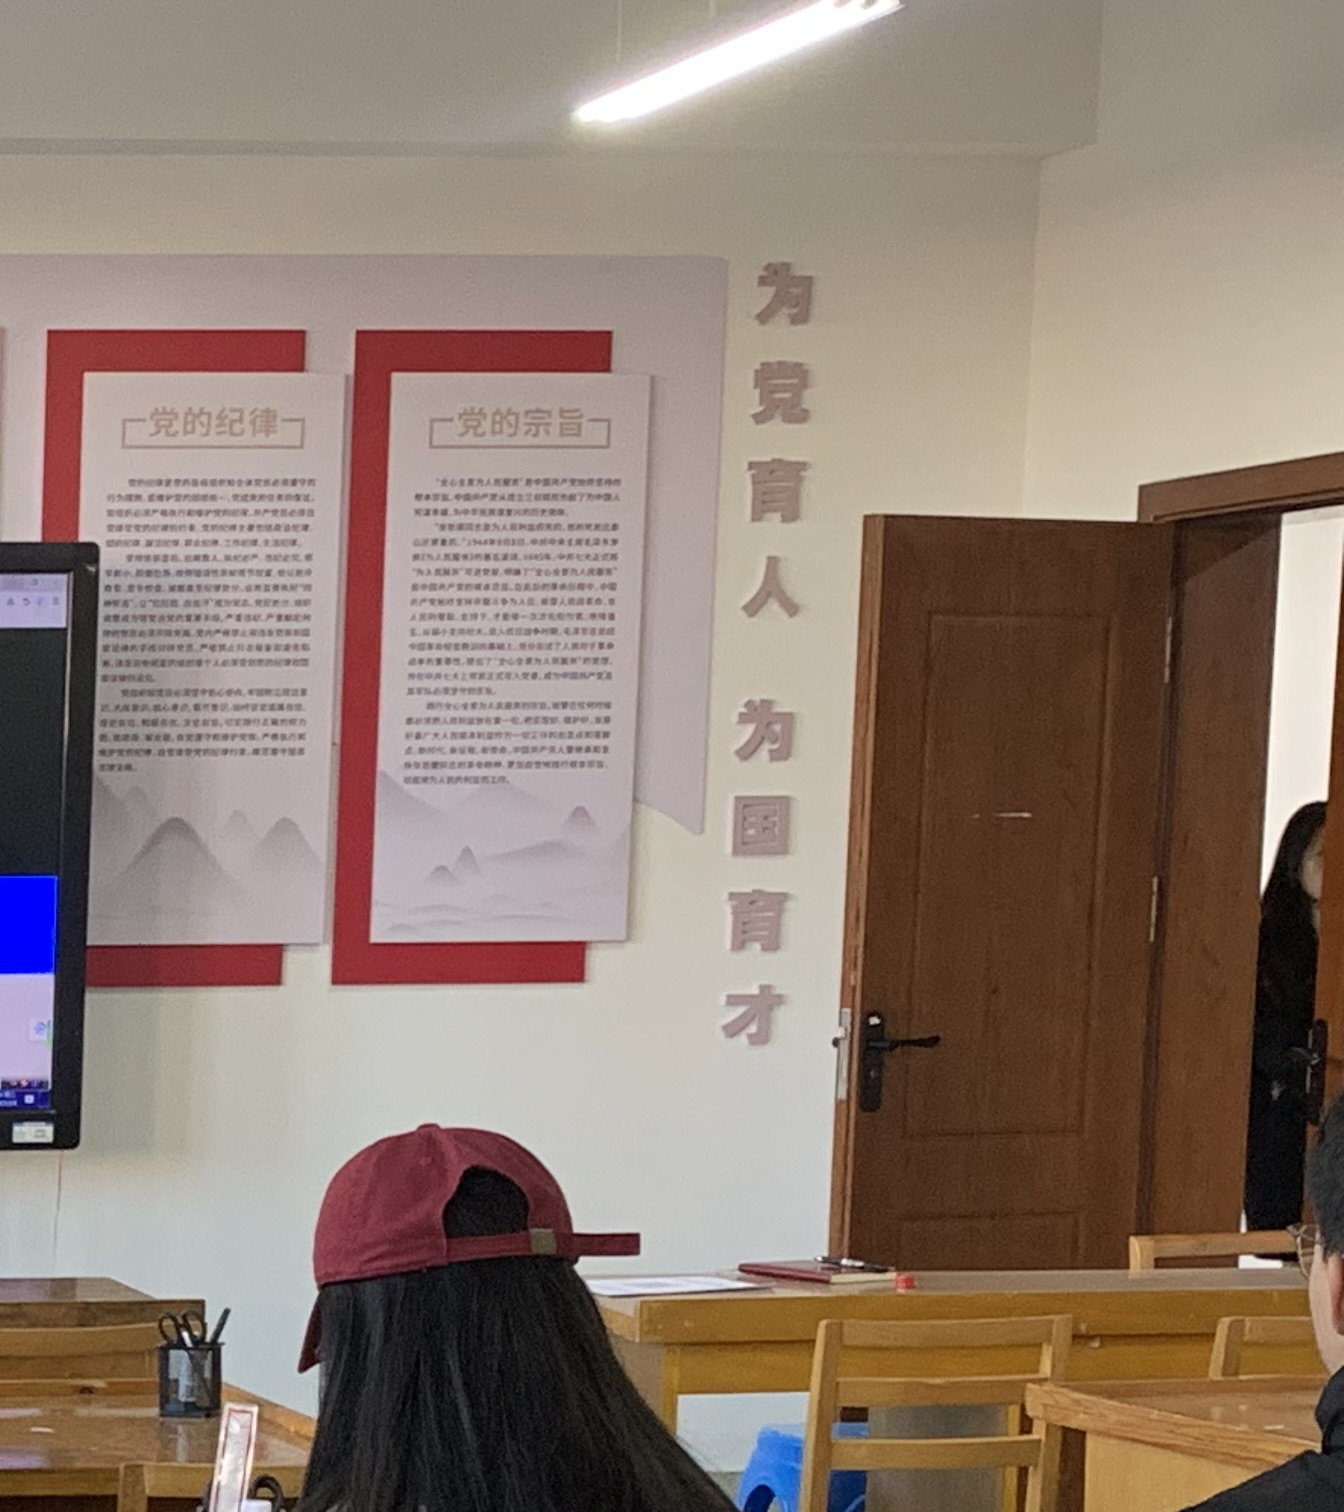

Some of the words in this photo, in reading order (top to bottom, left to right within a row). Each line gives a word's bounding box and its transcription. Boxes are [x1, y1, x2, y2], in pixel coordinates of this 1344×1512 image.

[149, 406, 279, 438] 党的纪律
[457, 406, 584, 438] 党的宗旨
[740, 262, 814, 618] 为党育人
[720, 698, 800, 1046] 为国育才
